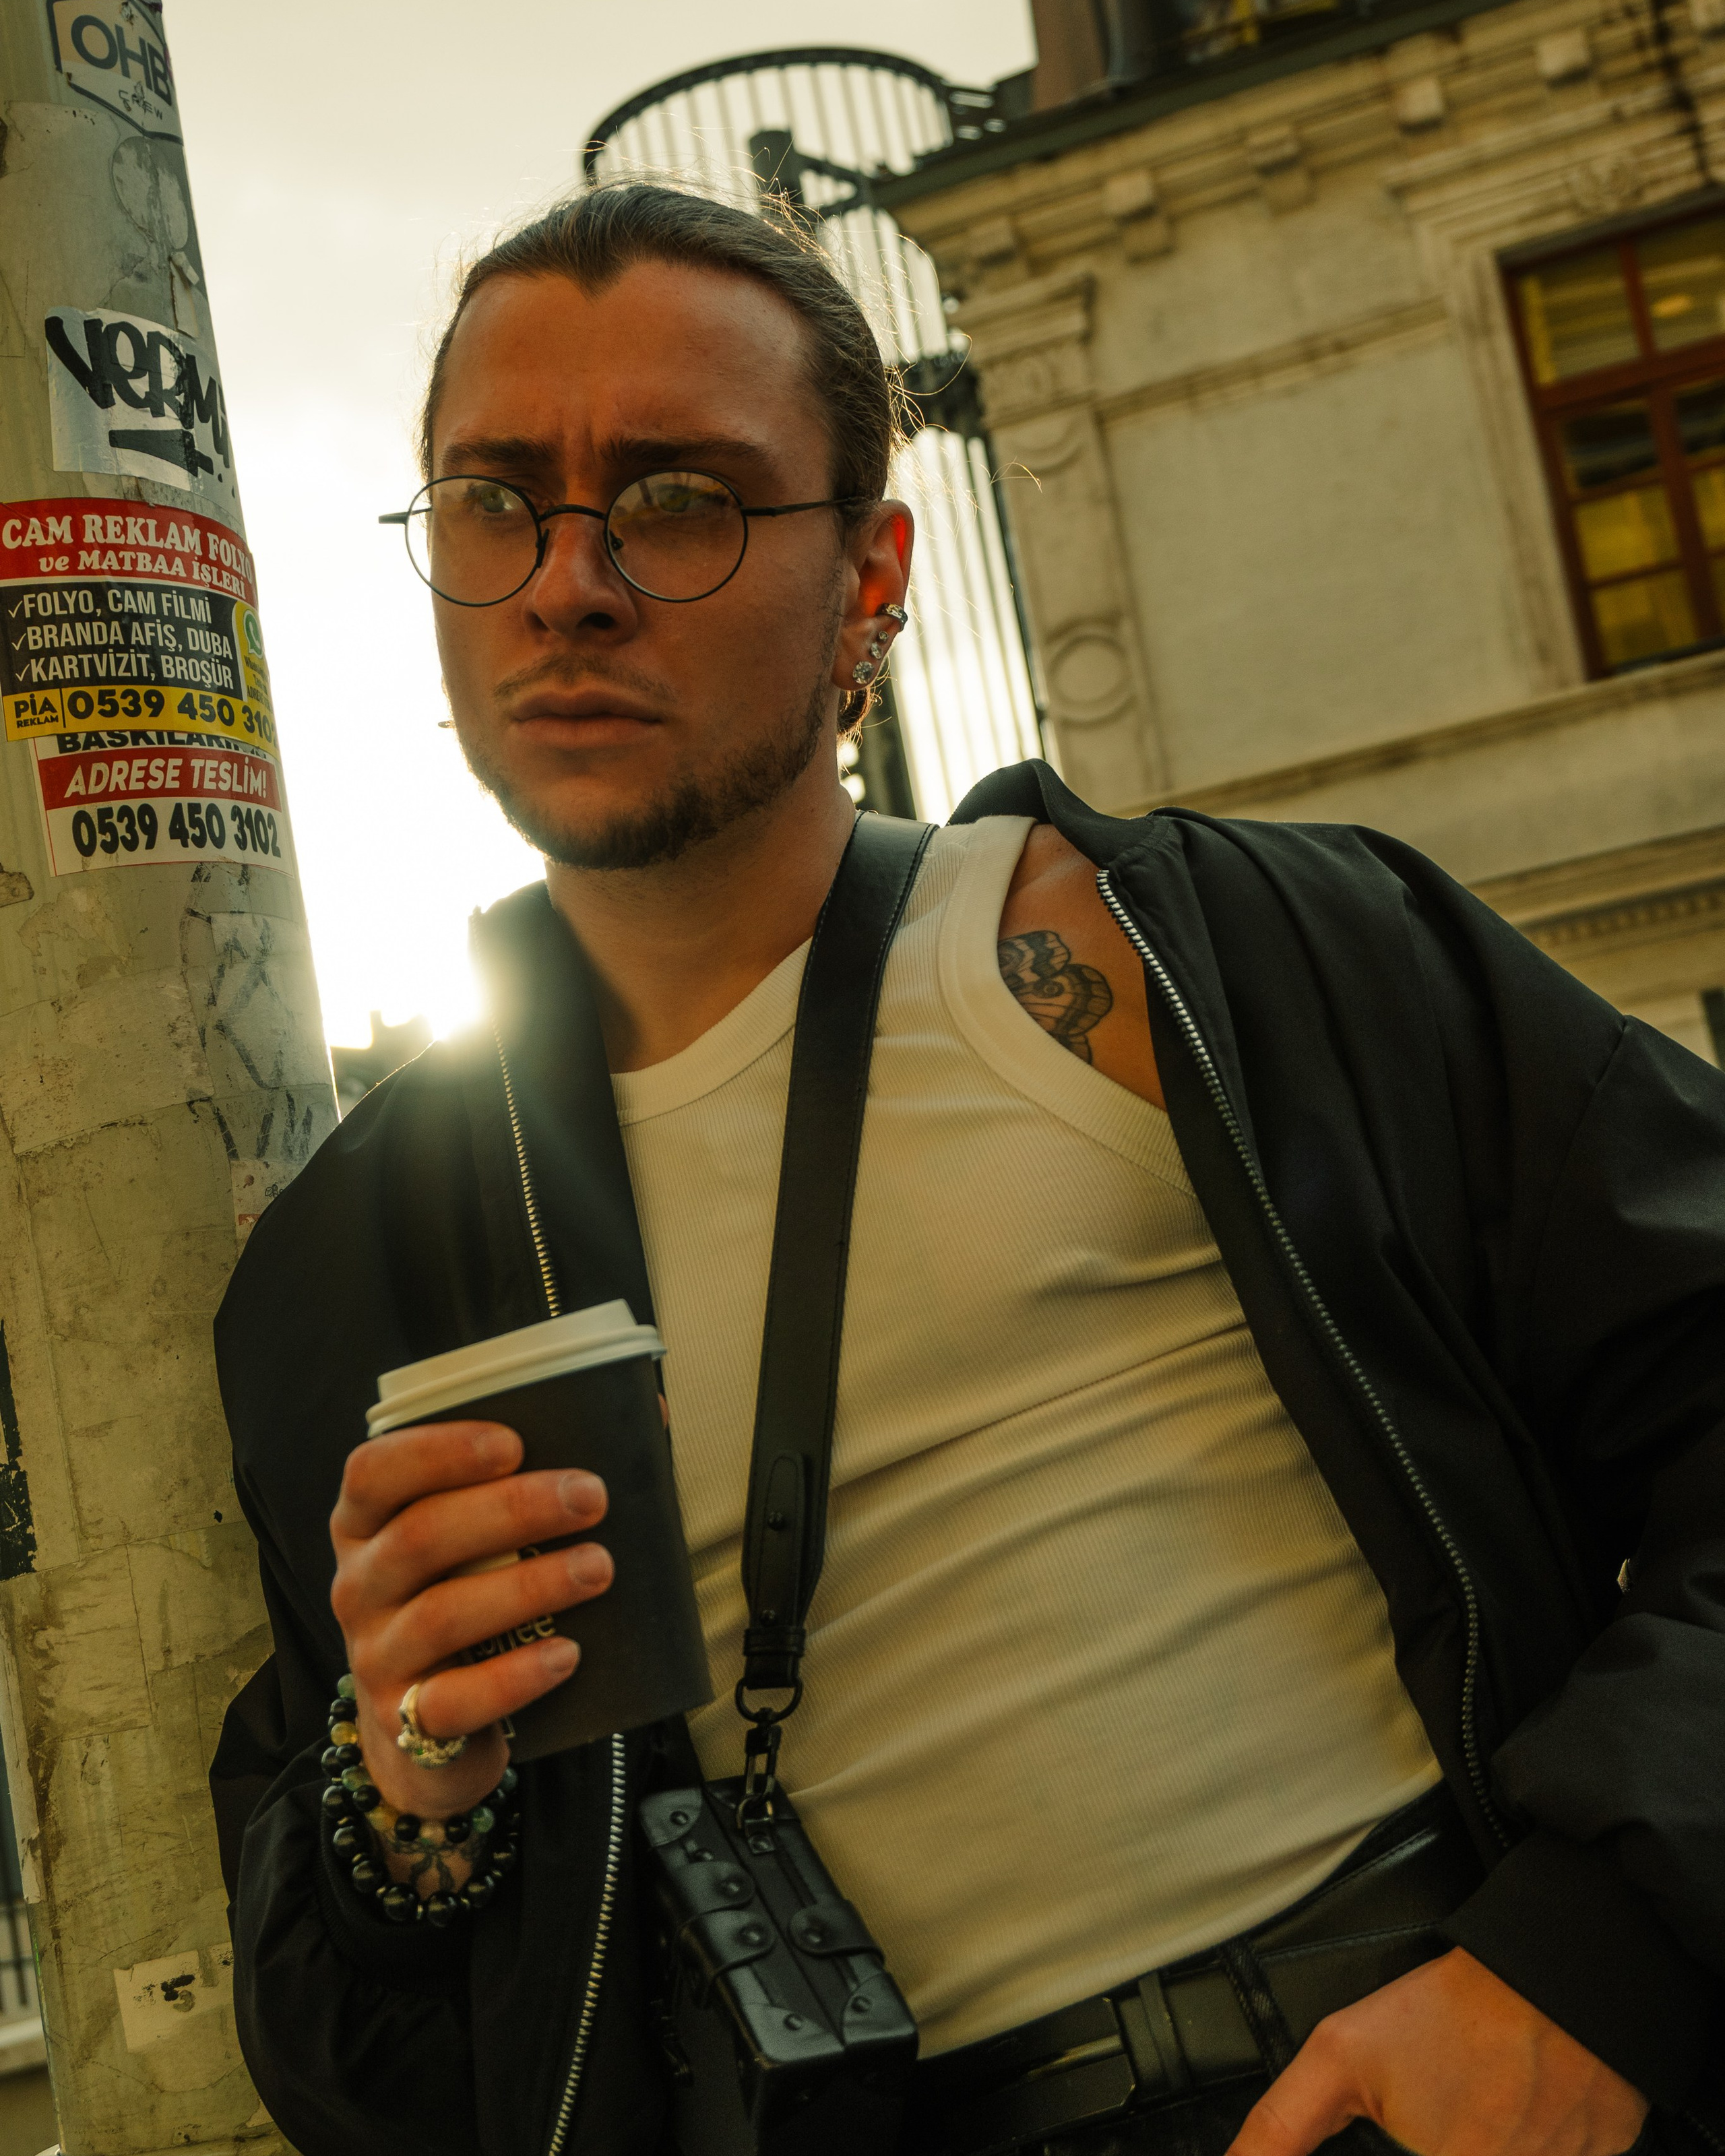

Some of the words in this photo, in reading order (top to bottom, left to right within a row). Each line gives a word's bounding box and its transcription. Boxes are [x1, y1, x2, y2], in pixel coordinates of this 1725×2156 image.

[71, 15, 172, 106] OHB
[119, 90, 162, 120] CREW
[2, 515, 73, 549] CAM
[82, 514, 203, 556] REKLAM
[207, 532, 253, 584] FOLYO
[38, 556, 69, 572] ve
[77, 550, 187, 577] MATBAA
[192, 557, 246, 600] İŞLERİ
[23, 590, 101, 619] FOLYO,
[107, 589, 156, 615] CAM
[161, 590, 212, 624] FİLMİ
[27, 621, 125, 650] BRANDA
[131, 619, 183, 652] AFİŞ,
[187, 627, 233, 660] DUBA
[30, 648, 156, 681] KARTVİZİT,
[160, 655, 234, 689] BROŞÜR
[14, 693, 57, 718] PİA
[17, 715, 59, 728] REKLAM
[67, 689, 164, 720] 0539
[177, 692, 234, 726] 450
[64, 758, 183, 798] ADRESE
[191, 756, 267, 798] TESLİM!
[72, 803, 158, 857] 0539
[169, 802, 226, 849] 450
[231, 804, 281, 858] 3102
